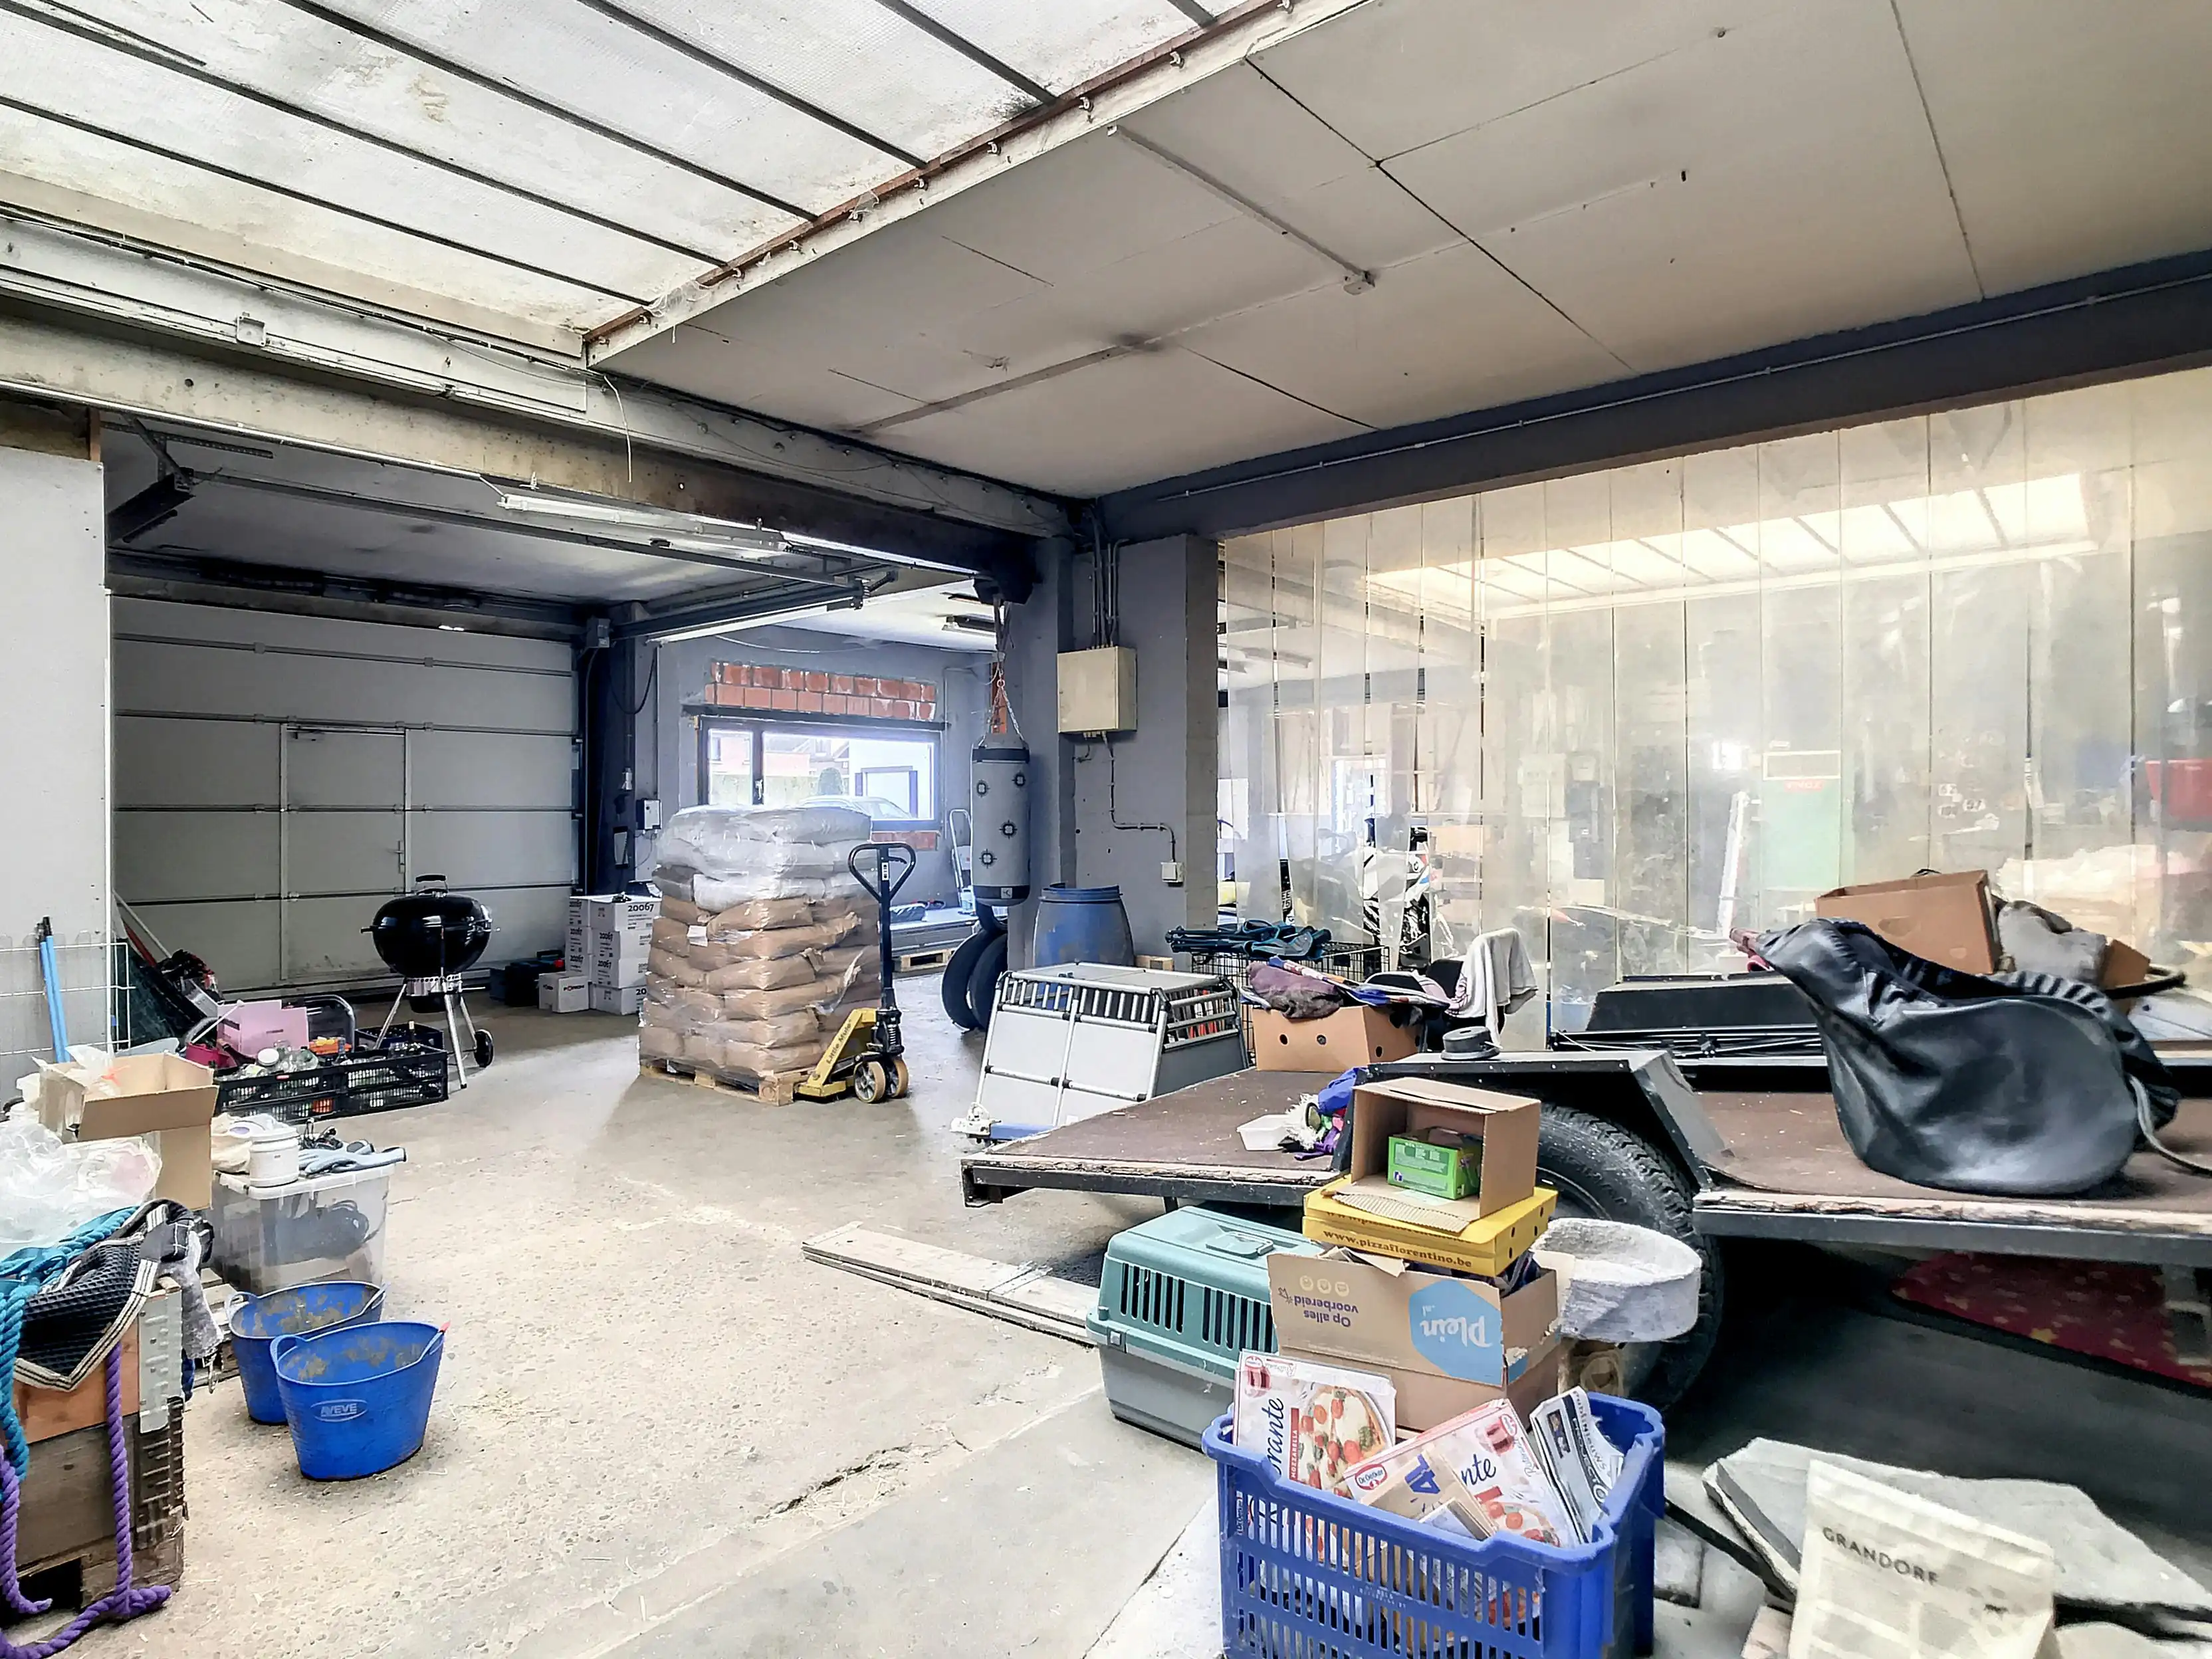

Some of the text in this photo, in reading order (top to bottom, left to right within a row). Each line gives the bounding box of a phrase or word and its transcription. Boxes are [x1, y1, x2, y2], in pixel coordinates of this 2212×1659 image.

[627, 902, 655, 912] 20067
[1323, 1230, 1472, 1268] www.pizzaflorentino.be
[1293, 1295, 1359, 1314] voorbereid
[1303, 1309, 1351, 1327] Op alles
[1420, 1315, 1493, 1347] Plein
[320, 1403, 357, 1416] AVEVE
[1822, 1527, 1939, 1585] GRANDORF
